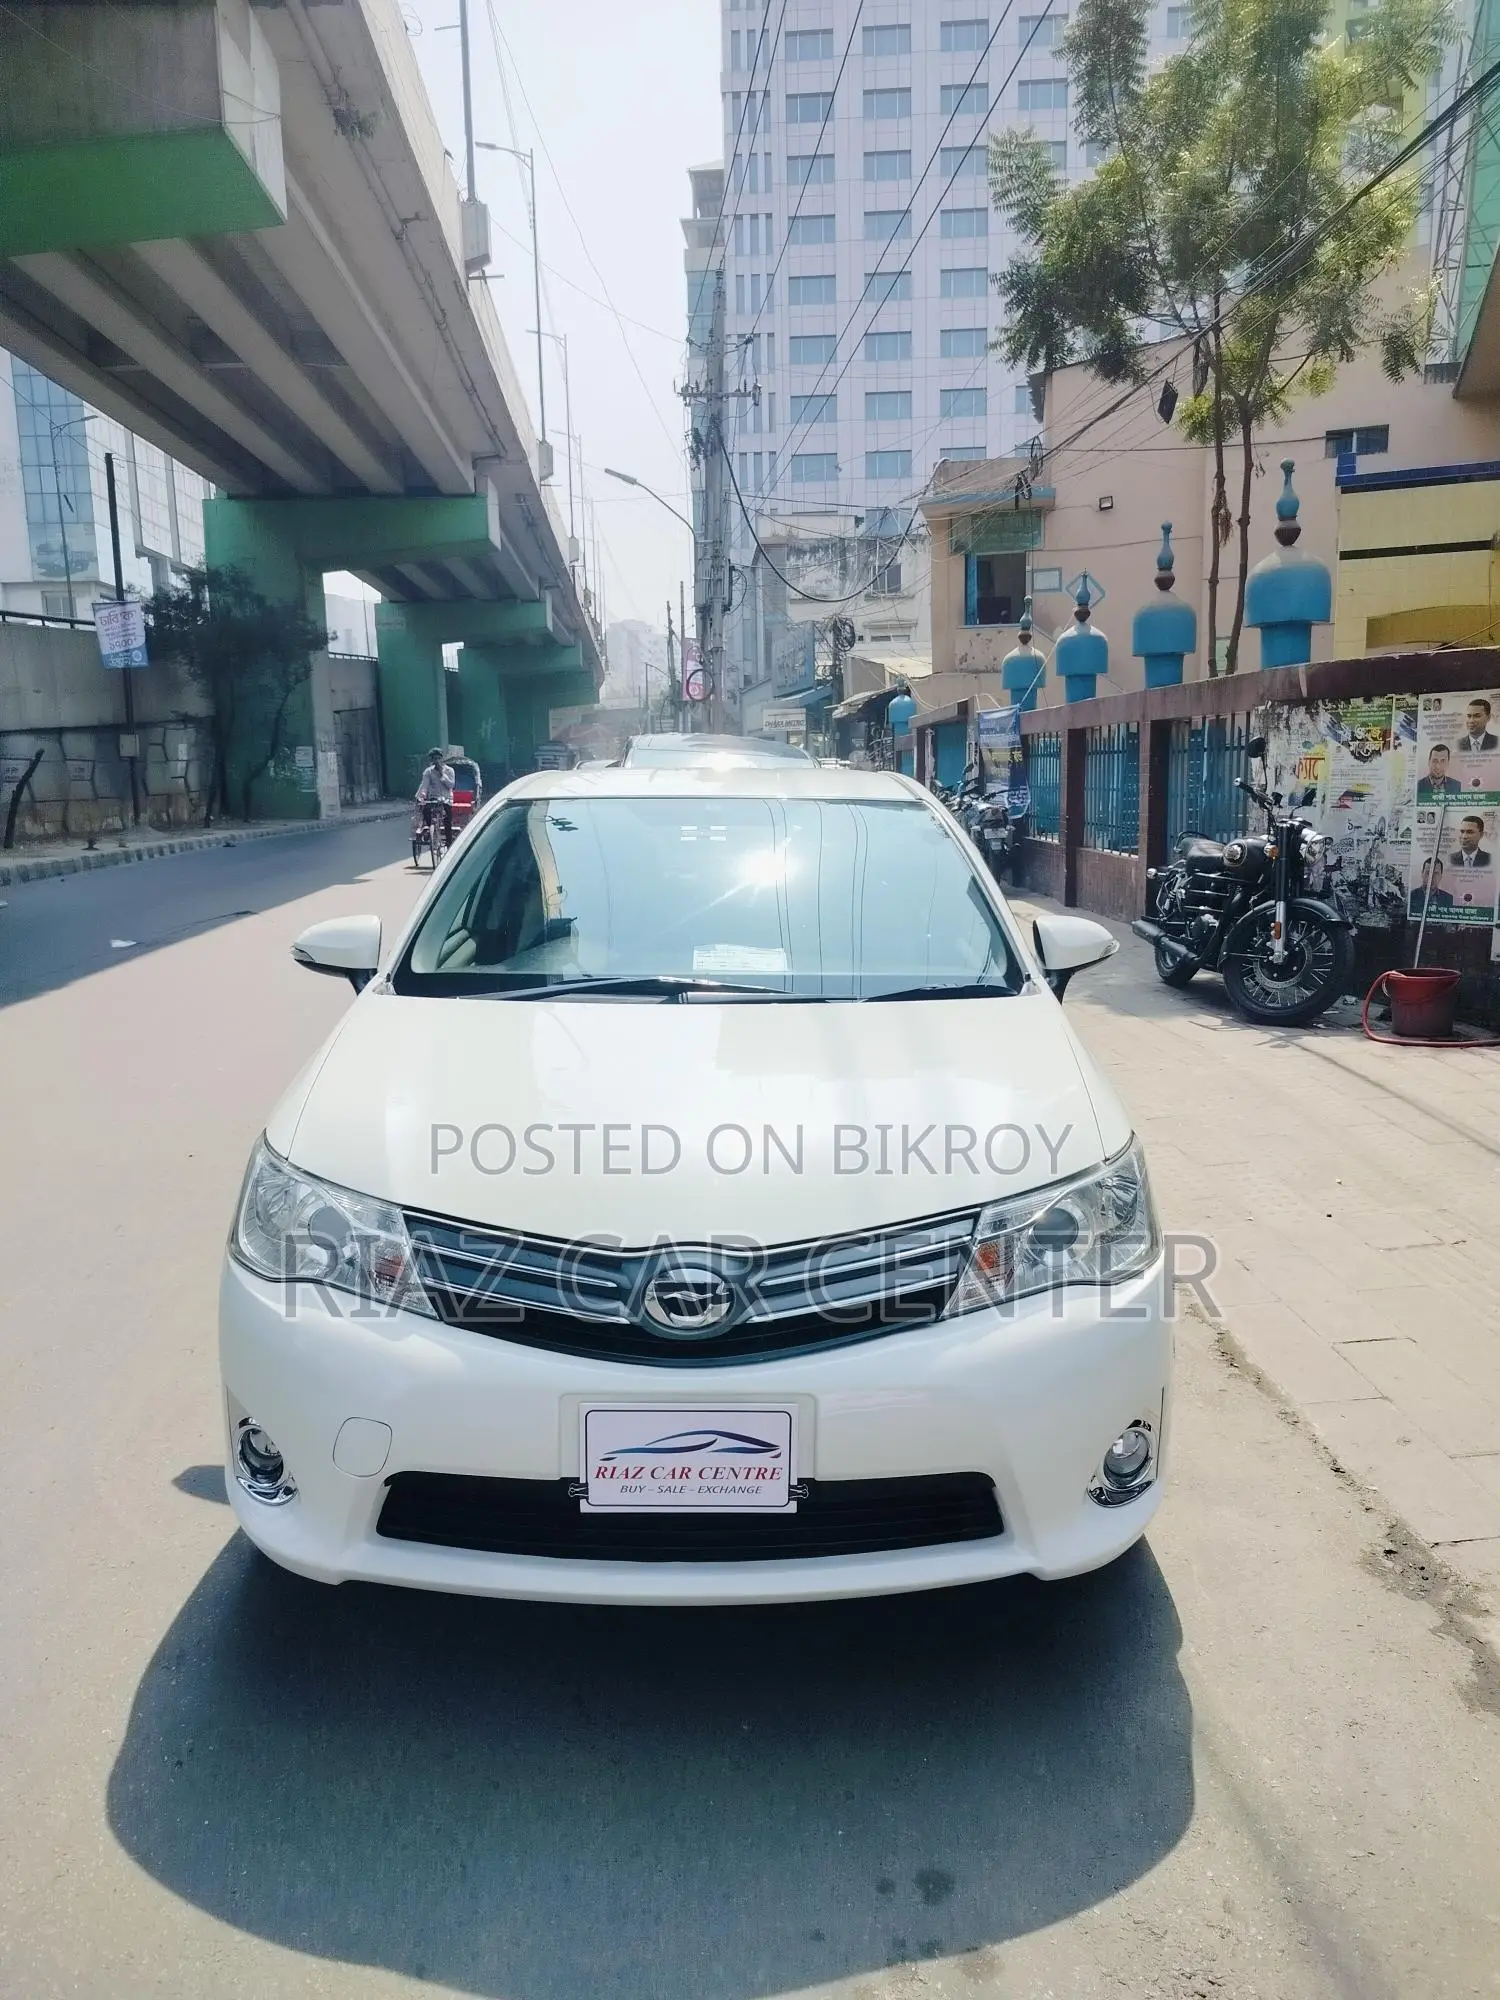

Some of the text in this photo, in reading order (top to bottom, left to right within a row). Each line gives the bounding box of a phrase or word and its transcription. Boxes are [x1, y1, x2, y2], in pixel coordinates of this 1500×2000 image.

[594, 1466, 783, 1480] RIAZ CAR CENTRE
[620, 1485, 647, 1494] BUY
[656, 1485, 686, 1494] SALE
[697, 1485, 763, 1494] EXCHANGE
